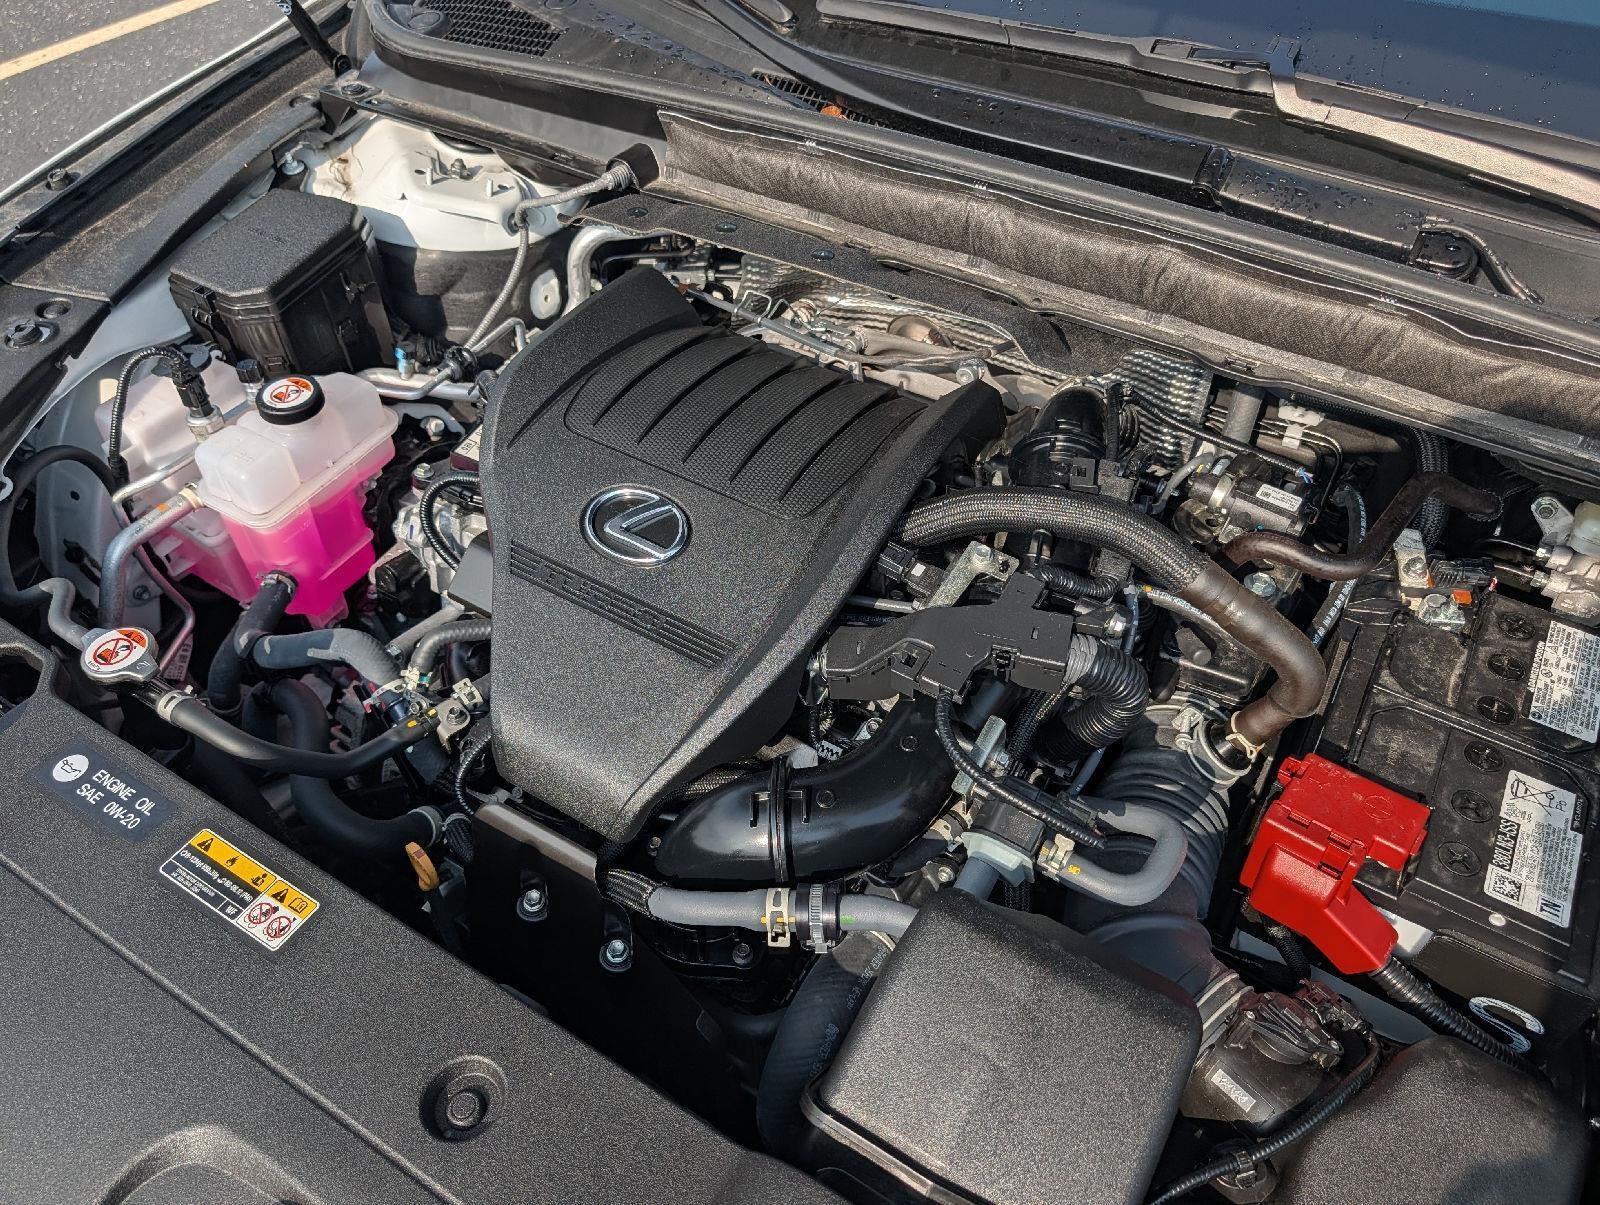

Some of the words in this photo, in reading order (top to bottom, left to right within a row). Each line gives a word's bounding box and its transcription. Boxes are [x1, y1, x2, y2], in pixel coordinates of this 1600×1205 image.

[76, 783, 105, 805] SAE
[103, 801, 141, 829] 0W-20
[92, 769, 137, 801] ENGINE
[135, 797, 156, 816] OIL
[1540, 898, 1562, 918] TN
